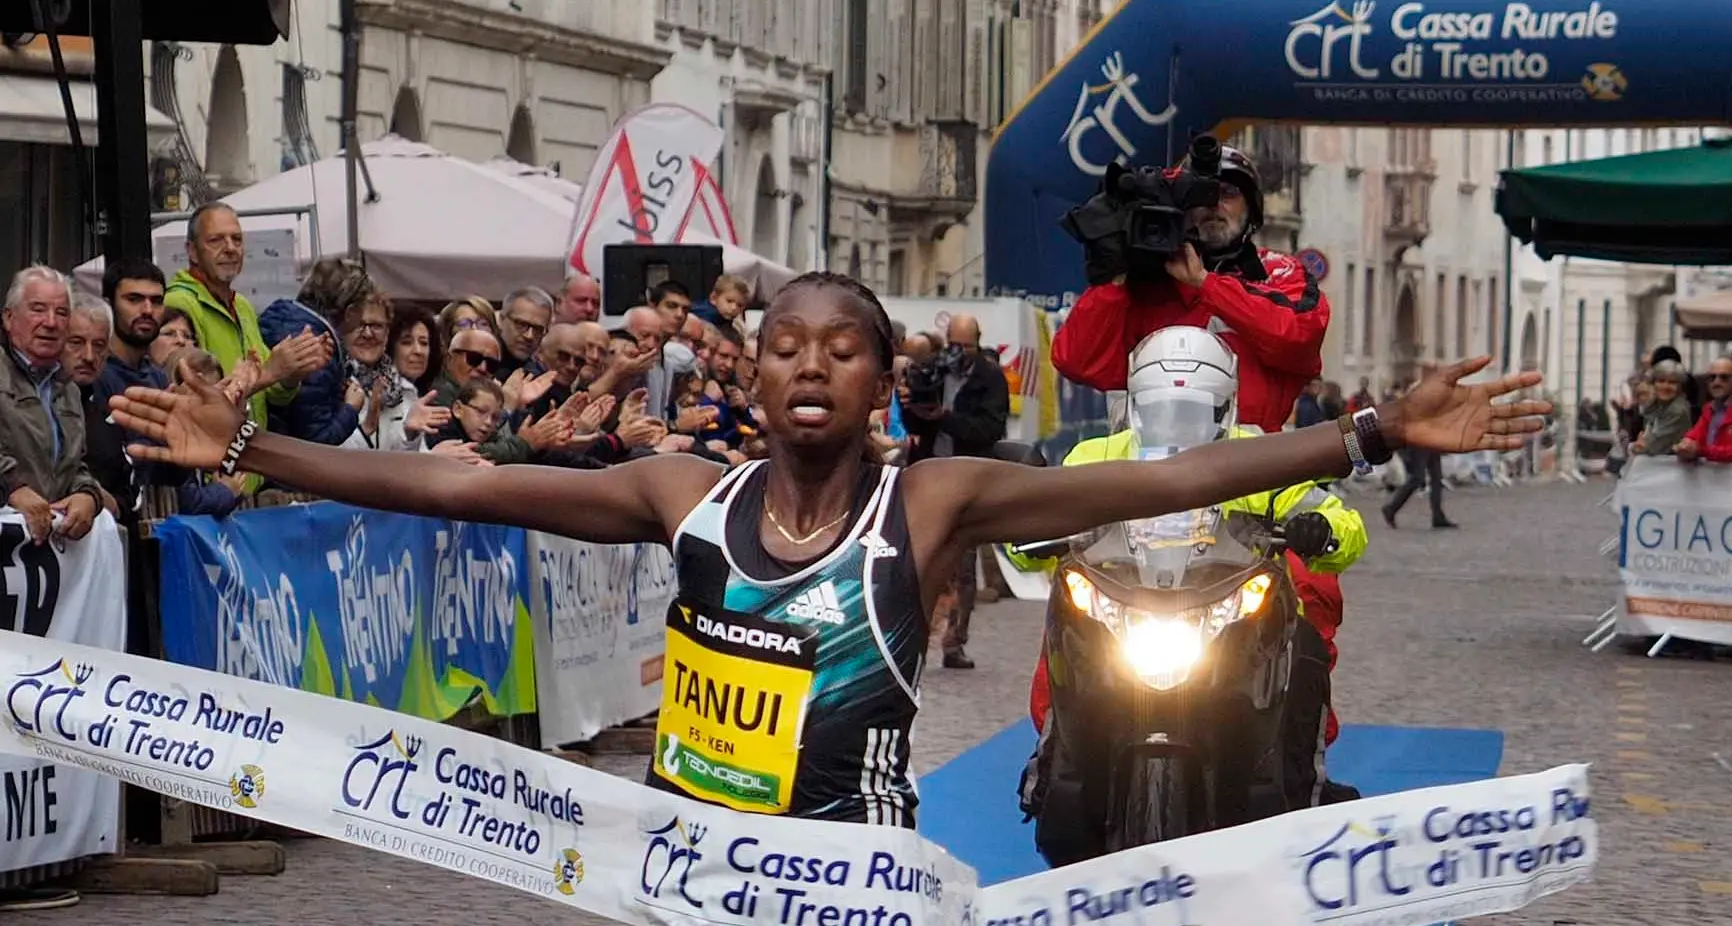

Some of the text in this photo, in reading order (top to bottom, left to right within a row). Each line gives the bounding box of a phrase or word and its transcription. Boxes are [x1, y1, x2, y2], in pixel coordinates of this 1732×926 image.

[1391, 2, 1618, 39] Cassa Rurale
[1390, 42, 1550, 79] di Trento
[1313, 88, 1586, 101] BANCA DI CREDITO COOPERATIVO
[786, 601, 845, 625] adidas
[696, 614, 801, 656] DIADORA
[104, 674, 284, 745] Cassa Rurale
[673, 658, 783, 737] TANUI
[87, 715, 215, 771] di Trento
[144, 774, 233, 810] COOPERATIVO
[435, 747, 585, 826] Cassa Rurale
[422, 792, 541, 855] di Trento
[1423, 805, 1537, 843] Cassa
[343, 823, 555, 896] BANCA DI CREDITO COOPERATIVO
[727, 836, 852, 886] Cassa
[1426, 848, 1461, 887] di
[721, 880, 761, 918] di
[1065, 865, 1197, 925] Rurale
